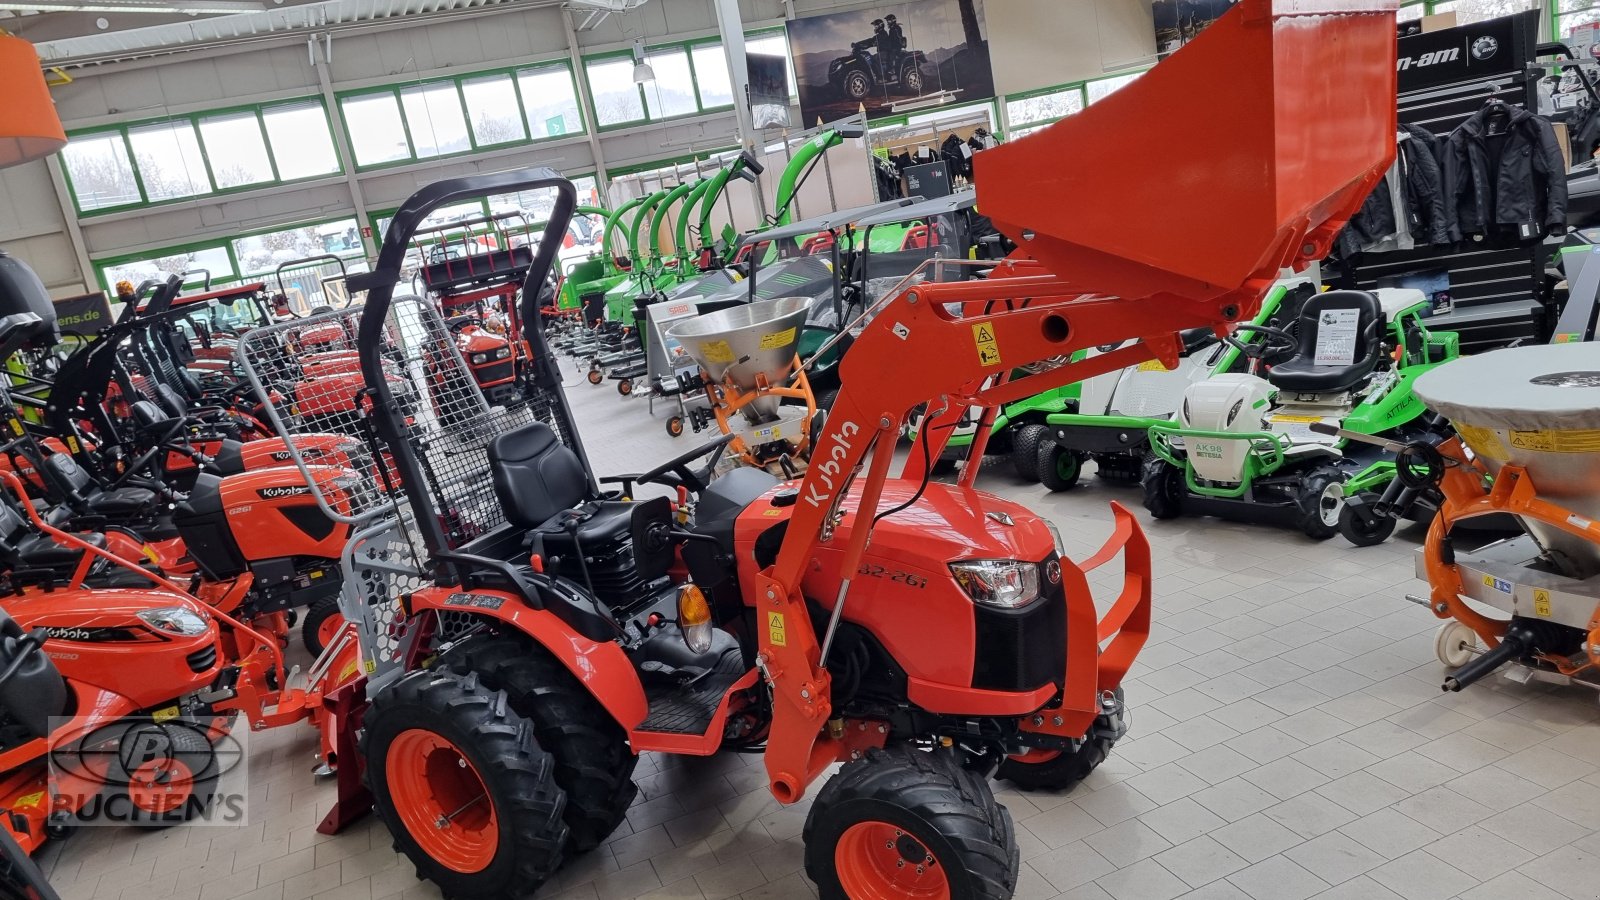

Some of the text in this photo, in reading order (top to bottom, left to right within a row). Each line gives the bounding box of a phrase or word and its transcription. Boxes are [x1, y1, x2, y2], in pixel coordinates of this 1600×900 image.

[1386, 396, 1414, 419] ATTILA
[1195, 443, 1222, 453] AK 98
[804, 421, 859, 508] Kubota
[264, 486, 303, 497] Kubota
[229, 505, 252, 515] G261
